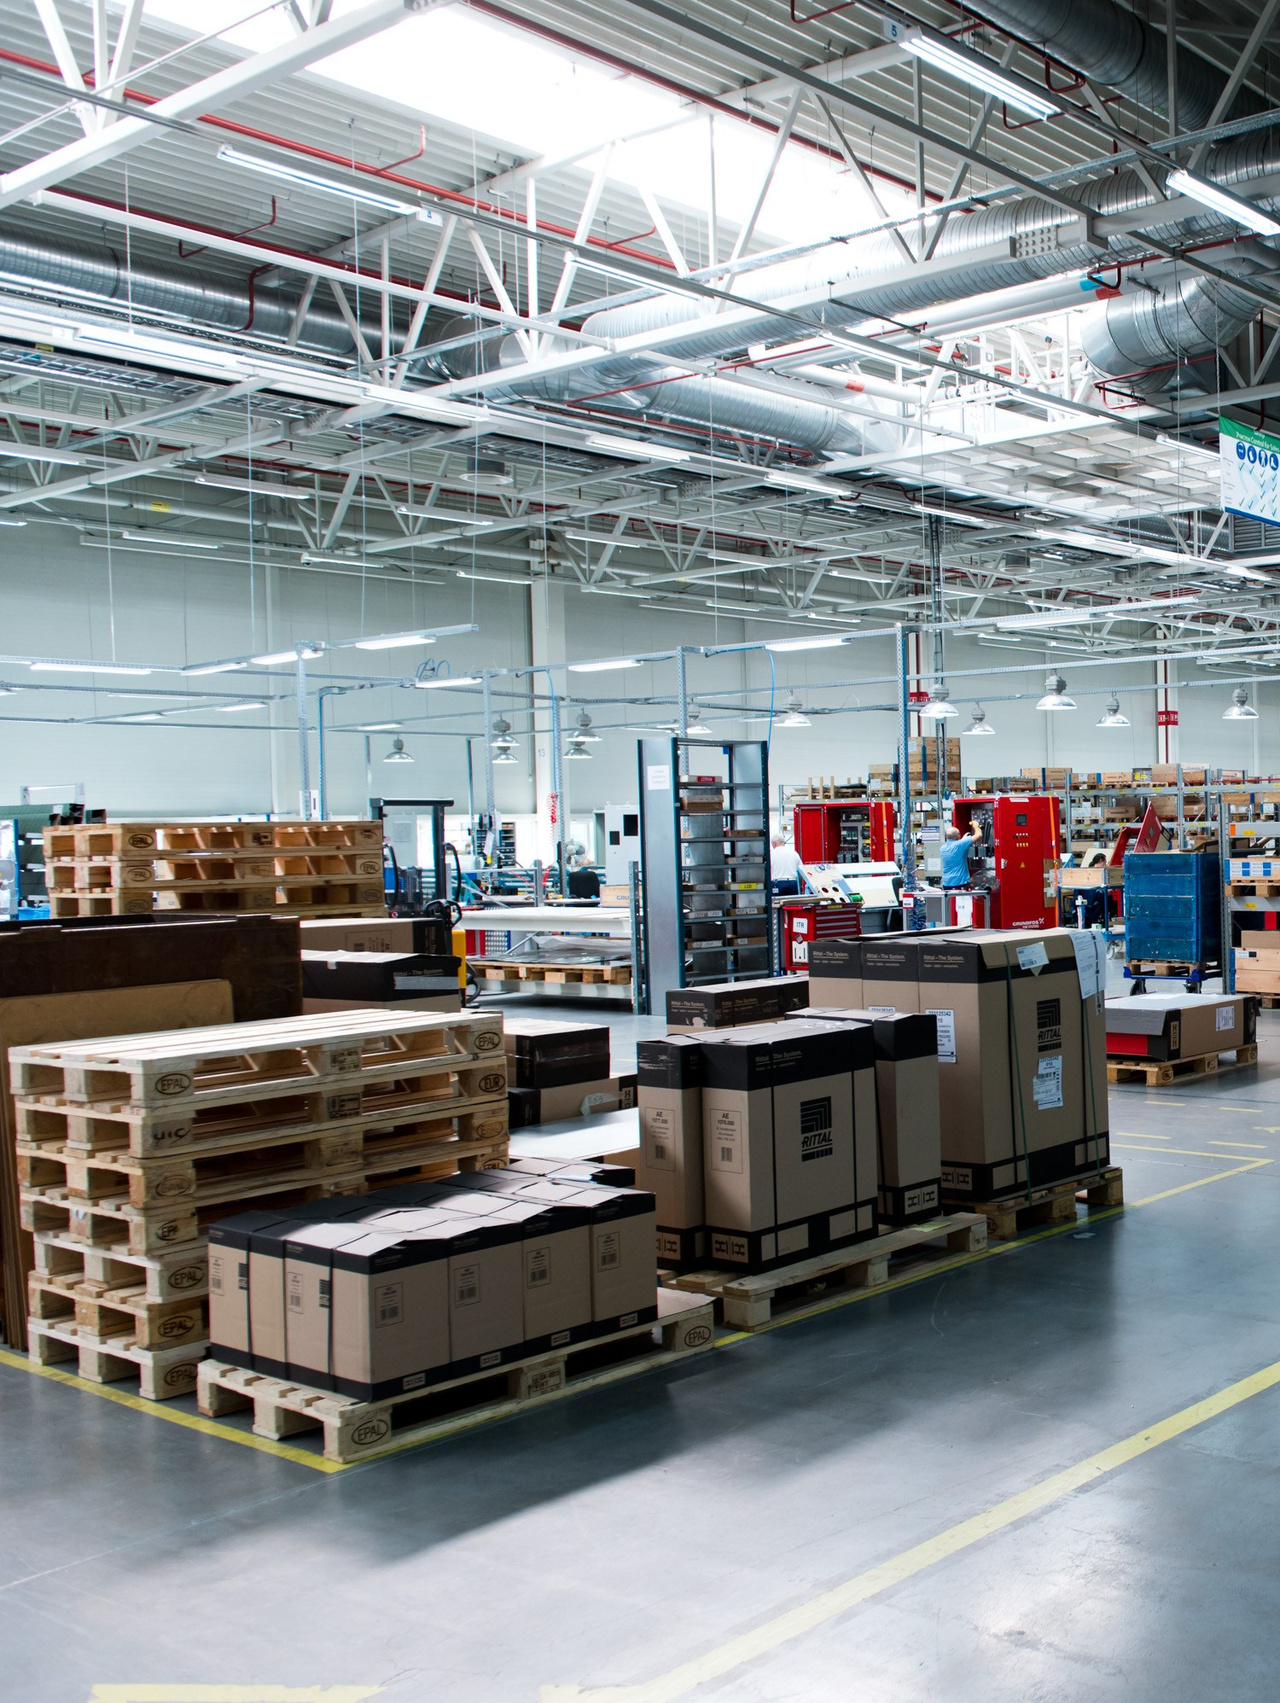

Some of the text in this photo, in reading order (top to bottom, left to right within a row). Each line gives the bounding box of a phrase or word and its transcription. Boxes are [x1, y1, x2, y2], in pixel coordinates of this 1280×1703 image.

[538, 749, 546, 757] 13
[478, 1035, 496, 1047] EPAL
[1038, 1027, 1061, 1041] RITTAL
[755, 1055, 769, 1063] Rittal
[160, 1077, 187, 1092] EPAL
[484, 1077, 500, 1090] EUR
[801, 1130, 832, 1148] RITTAL
[174, 1269, 198, 1286] EPAL
[163, 1319, 190, 1335] EPAL
[688, 1328, 707, 1344] EPAL
[357, 1427, 384, 1441] EPAL
